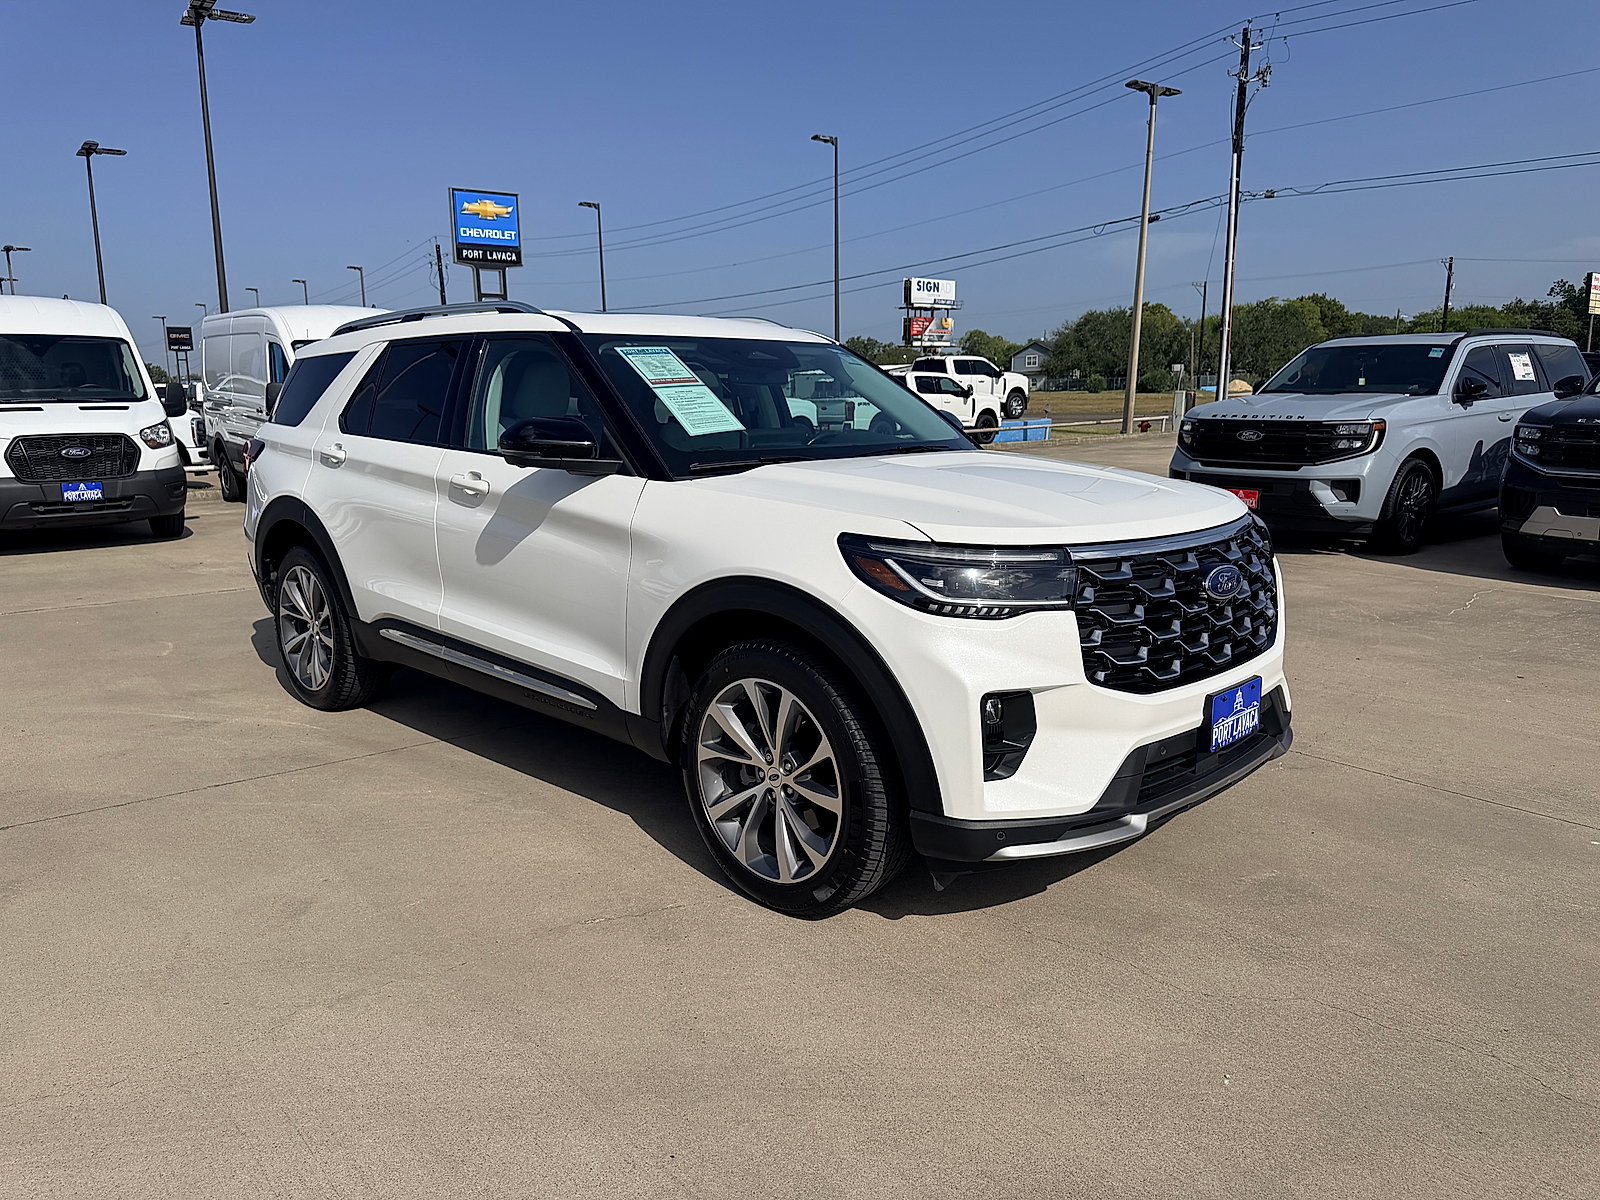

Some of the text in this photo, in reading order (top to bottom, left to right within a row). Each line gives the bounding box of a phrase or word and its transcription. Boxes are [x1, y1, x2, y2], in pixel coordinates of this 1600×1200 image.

[460, 227, 517, 240] CHEVROLET
[462, 249, 517, 262] PORT LAVACA
[916, 280, 940, 293] SIGN
[1240, 431, 1258, 440] Ford
[67, 448, 85, 456] Ford
[63, 489, 103, 501] PORT LAVACA
[1217, 571, 1238, 593] Ford
[523, 692, 595, 719] EXPLORER
[1212, 708, 1258, 746] PORT LAVACA
